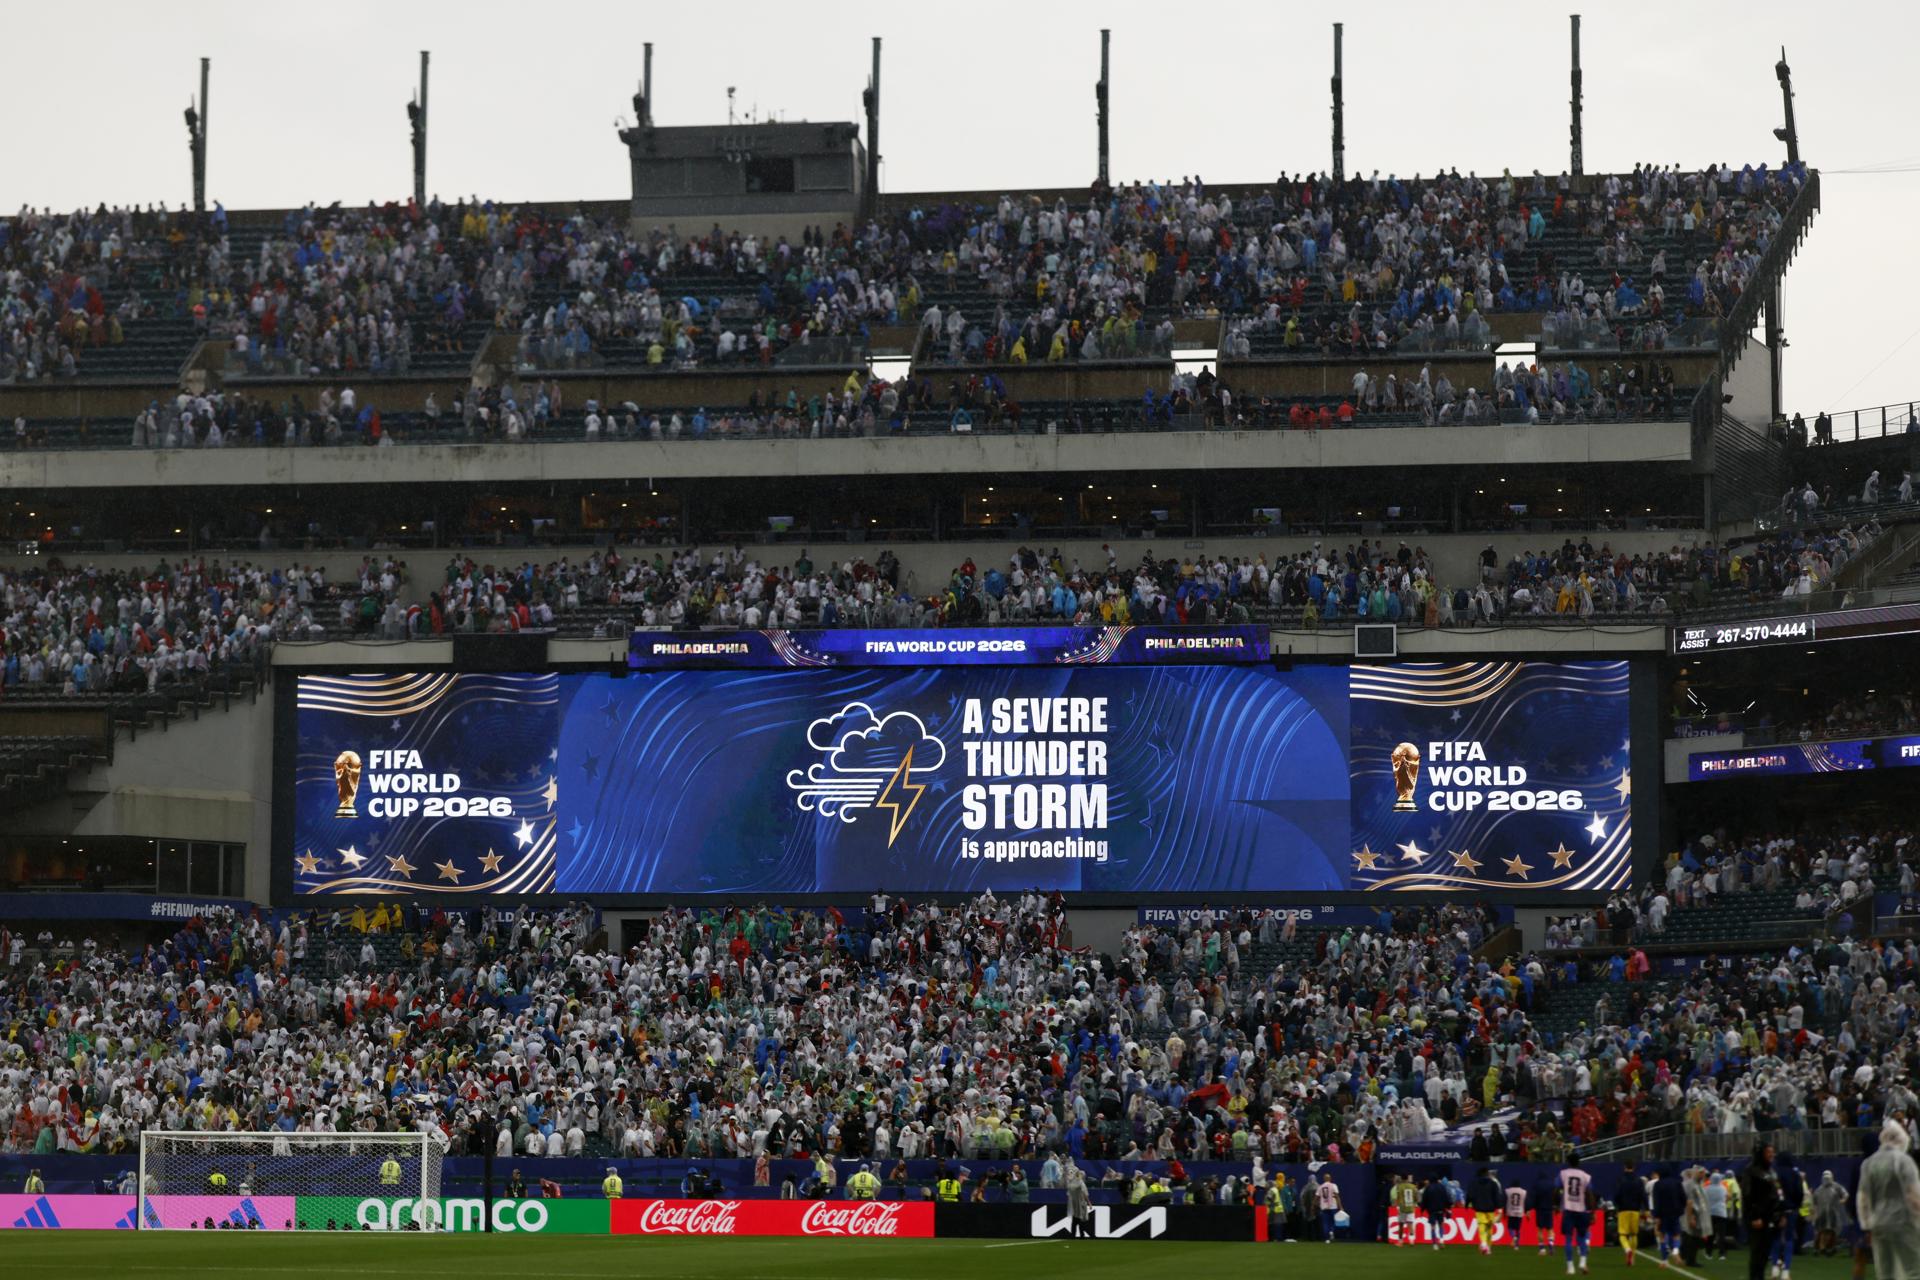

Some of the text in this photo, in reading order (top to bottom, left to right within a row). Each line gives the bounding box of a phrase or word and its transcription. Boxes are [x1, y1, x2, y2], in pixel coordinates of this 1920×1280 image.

[1685, 630, 1706, 640] TEXT
[1716, 622, 1807, 644] 267-570-4444
[653, 643, 749, 655] PHILADELPHIA
[866, 640, 1026, 653] FIFA WORLD CUP 2026
[1145, 638, 1245, 649] PHILADELPHIA
[1680, 639, 1710, 650] ASSIST
[963, 698, 1108, 733] A SEVERE
[369, 749, 423, 769] FIFA
[963, 741, 1108, 776] THUNDER
[1428, 741, 1487, 762] FIFA
[1901, 745, 1920, 757] FIF
[1702, 755, 1787, 772] PHILADELPHIA
[368, 774, 461, 793] WORLD
[1428, 766, 1527, 786] WORLD
[368, 797, 512, 817] CUP 2026
[962, 784, 1108, 830] STORM
[1428, 790, 1583, 811] CUP 2026
[961, 837, 1108, 862] is approaching
[1145, 910, 1176, 920] FIFA
[1380, 1152, 1461, 1160] PHILADELPHIA
[357, 1198, 548, 1232] aramco
[641, 1200, 742, 1233] Coca-Cola
[801, 1200, 904, 1235] Coca-Cola
